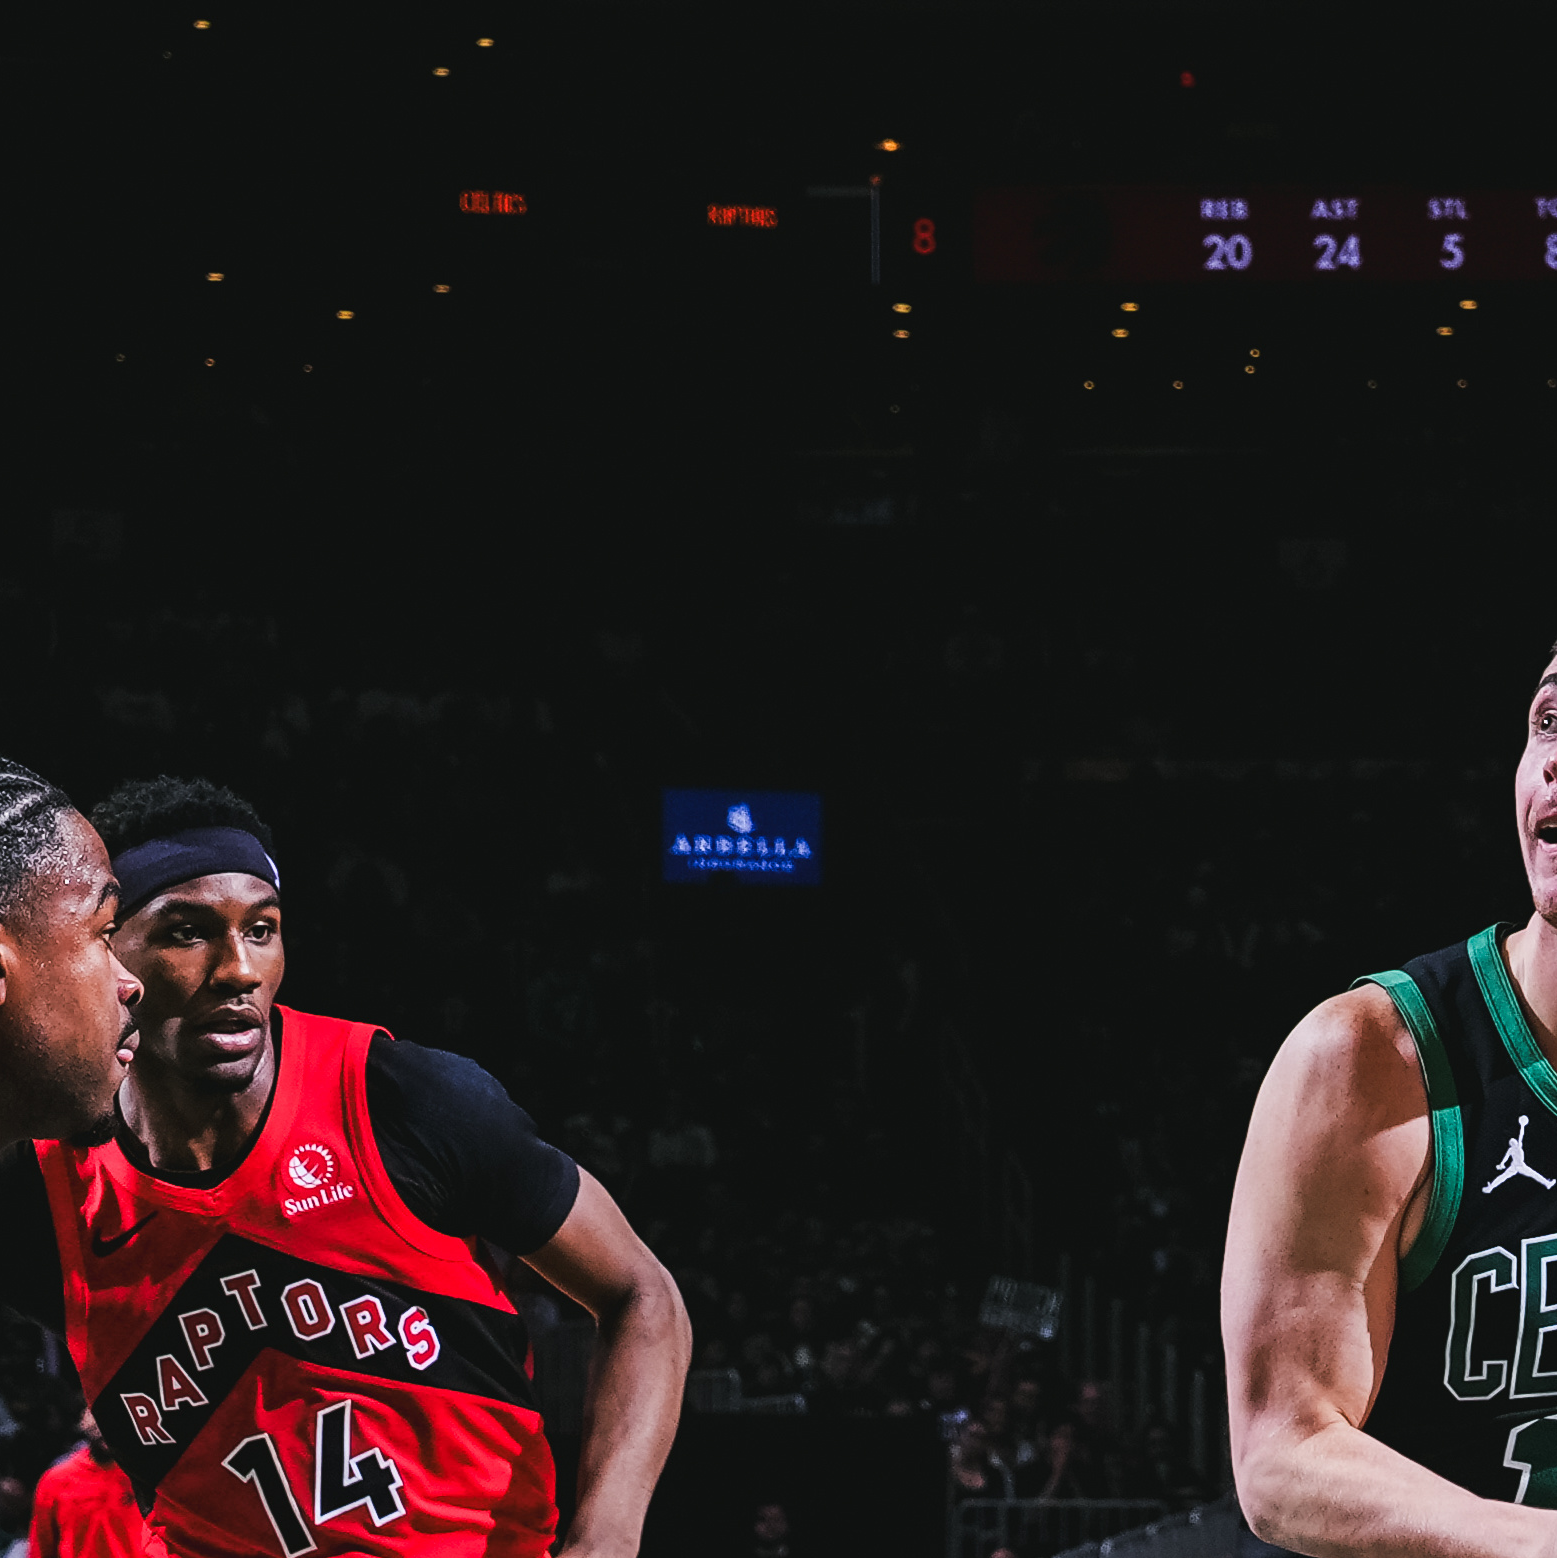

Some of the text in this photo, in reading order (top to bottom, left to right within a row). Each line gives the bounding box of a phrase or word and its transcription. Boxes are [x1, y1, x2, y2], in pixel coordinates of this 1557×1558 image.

[913, 218, 938, 255] 8
[1203, 233, 1254, 272] 20
[1313, 233, 1363, 271] 24
[1441, 232, 1466, 271] 5
[284, 1181, 354, 1216] Sun Life
[119, 1269, 441, 1447] RAPTORS
